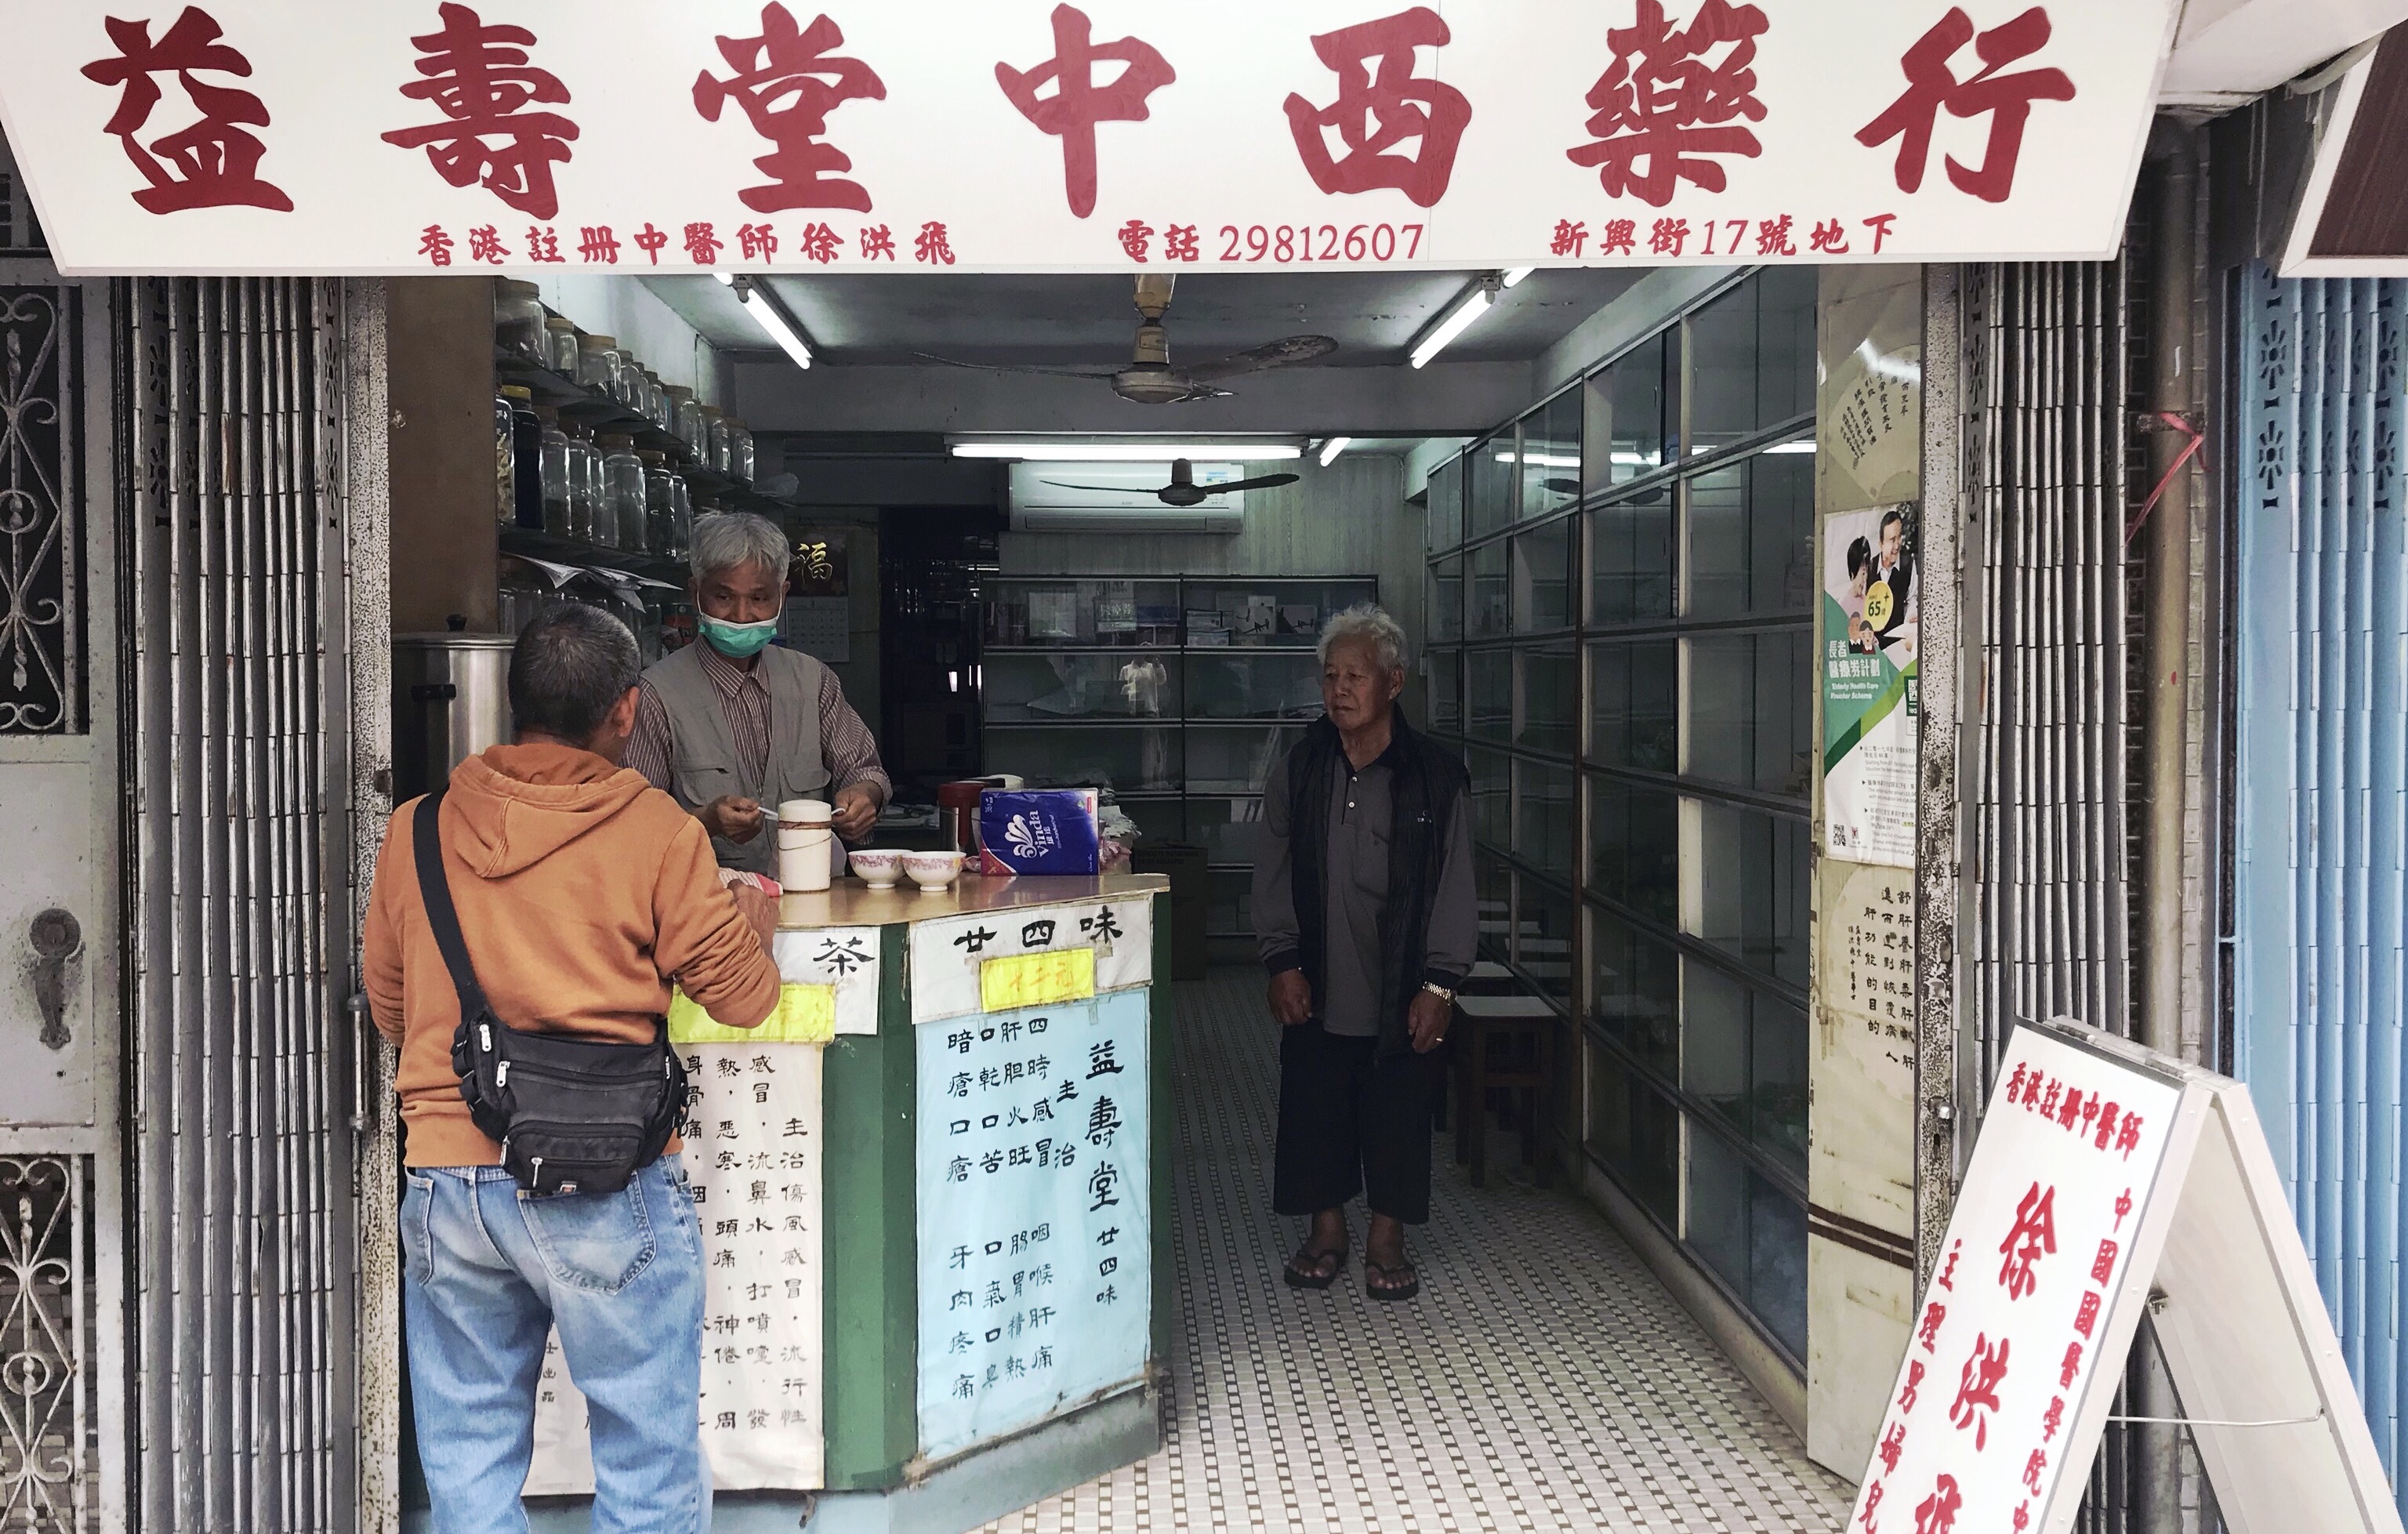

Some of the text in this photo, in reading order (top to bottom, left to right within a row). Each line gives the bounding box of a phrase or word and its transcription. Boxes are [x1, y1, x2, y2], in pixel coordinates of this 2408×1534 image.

[80, 1, 2076, 217] 益壽堂中西藥行
[1117, 223, 1424, 264] 電話 29812607
[1550, 214, 1898, 259] 新興街17號地下
[790, 542, 833, 585] 福
[1828, 658, 1880, 679] 醫療券計劃
[1829, 640, 1848, 658] 長者
[1832, 682, 1848, 691] Elderly
[1029, 810, 1050, 858] Vinda
[953, 905, 1123, 953] 廿四味
[813, 937, 875, 977] 茶
